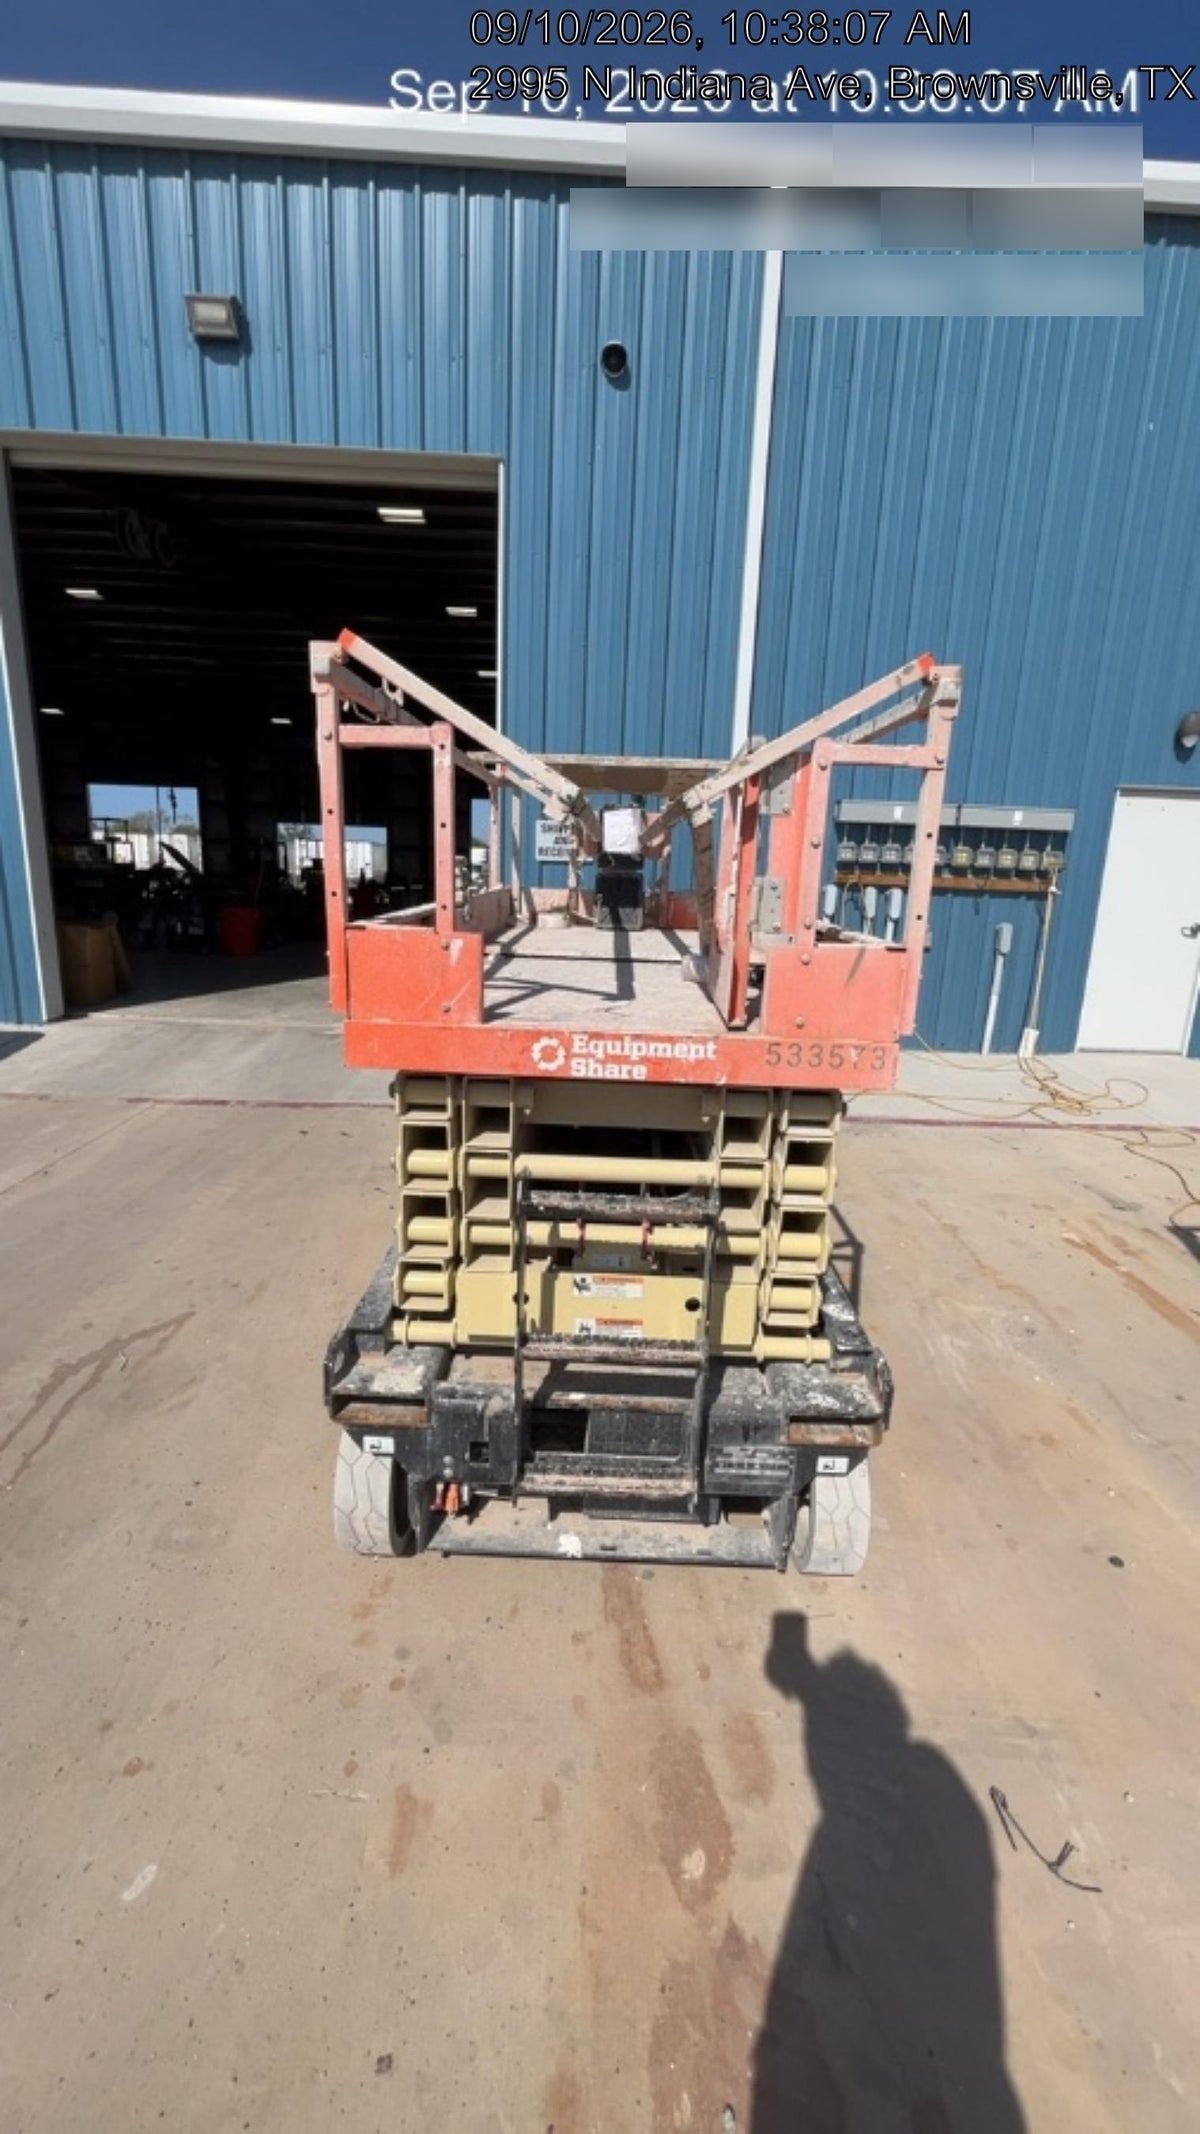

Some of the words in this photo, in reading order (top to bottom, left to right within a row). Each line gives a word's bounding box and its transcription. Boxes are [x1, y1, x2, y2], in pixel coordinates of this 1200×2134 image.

[571, 1033, 717, 1061] Equipment
[766, 1042, 886, 1070] 533573
[571, 1056, 647, 1080] Share
